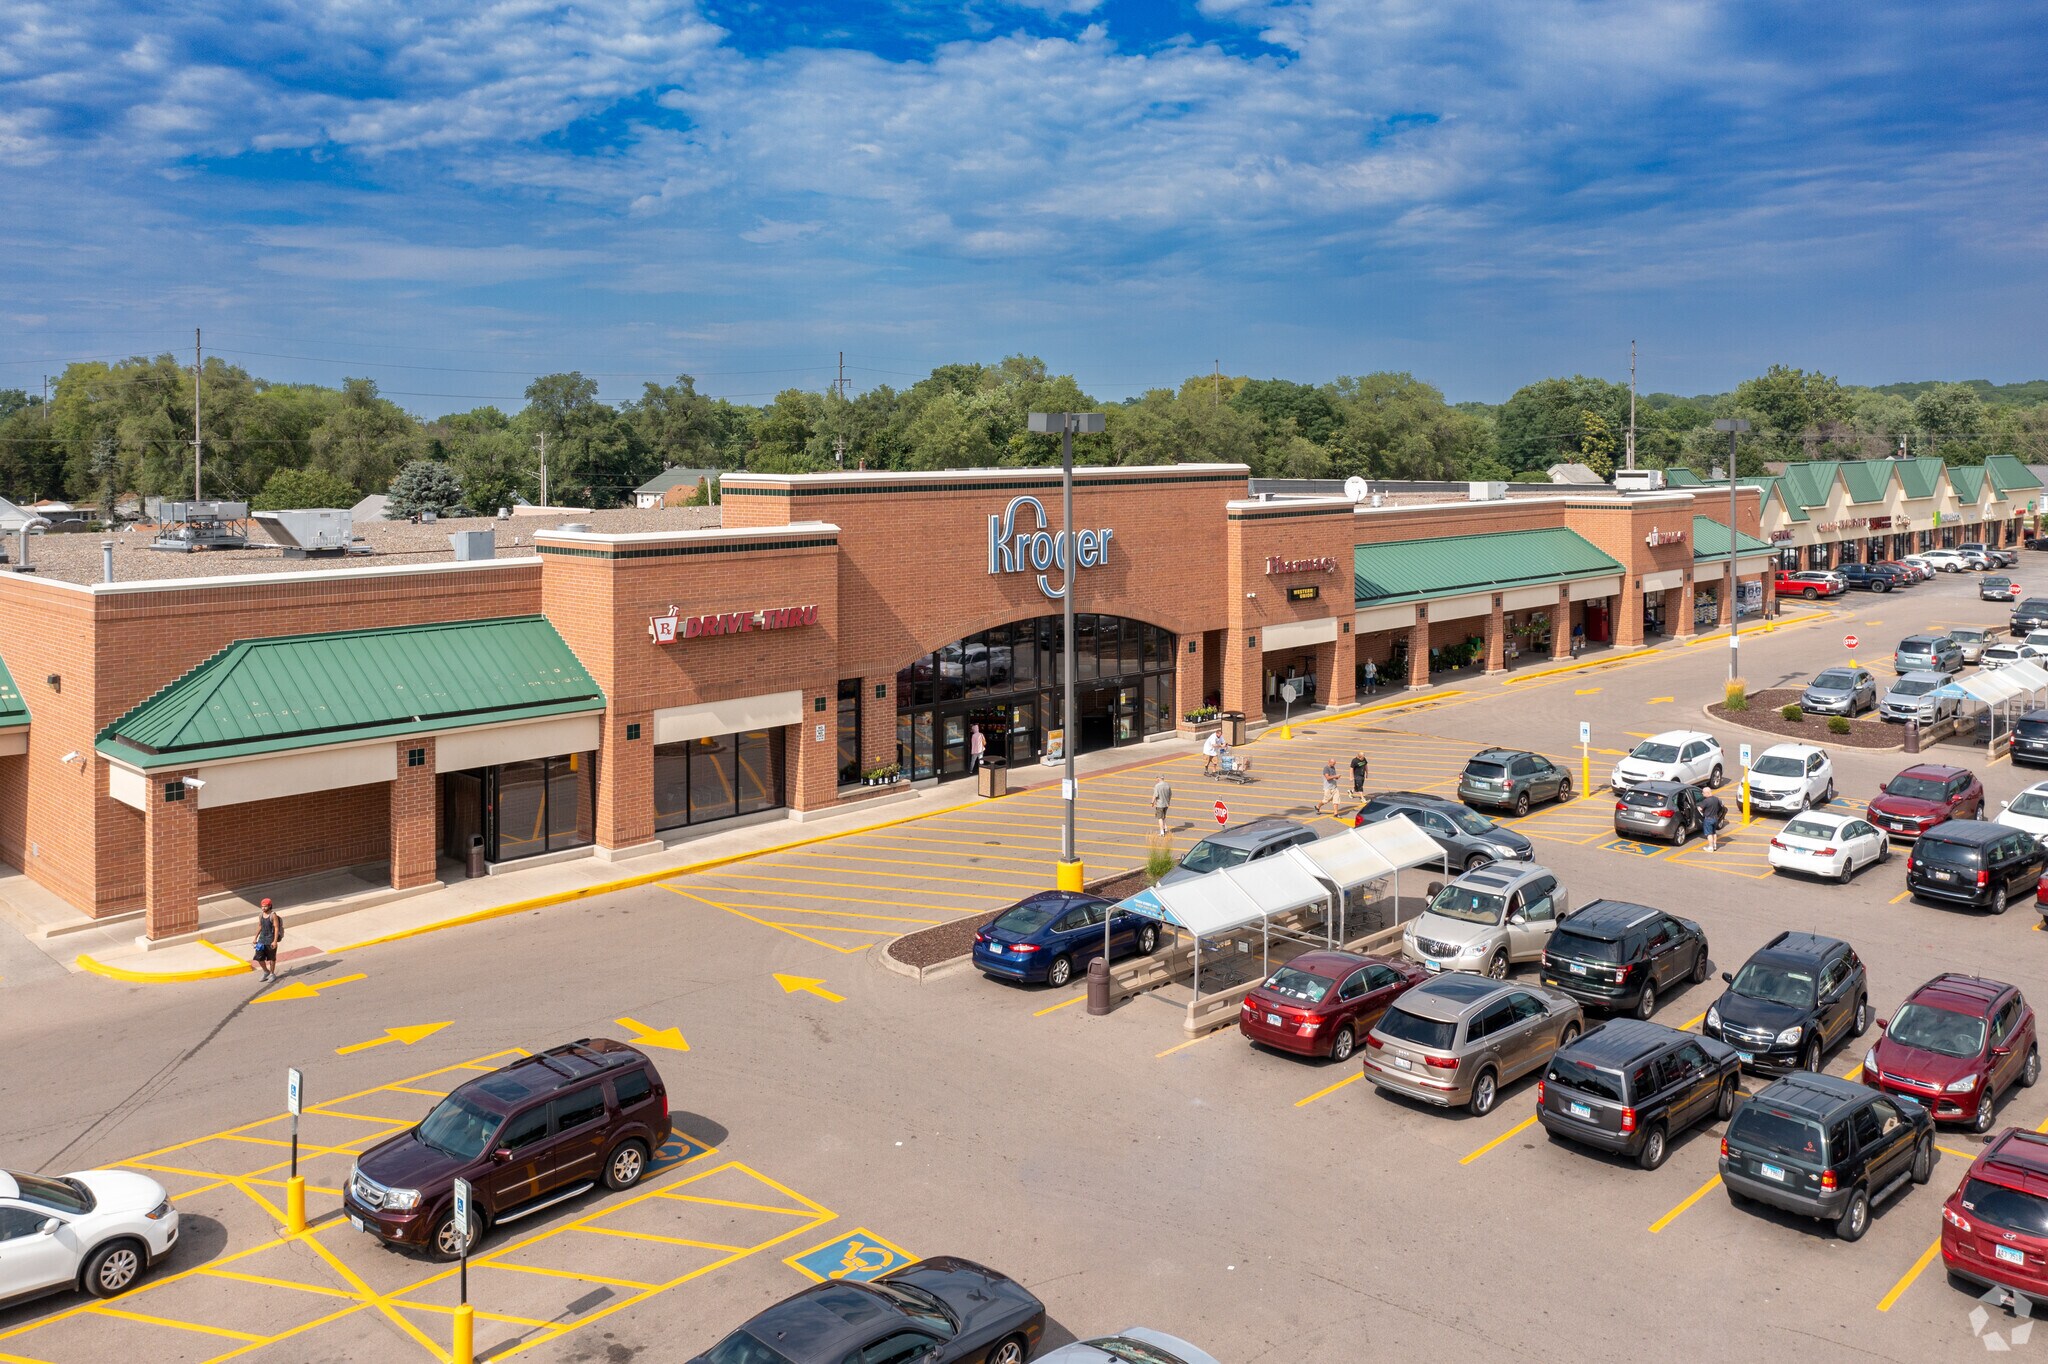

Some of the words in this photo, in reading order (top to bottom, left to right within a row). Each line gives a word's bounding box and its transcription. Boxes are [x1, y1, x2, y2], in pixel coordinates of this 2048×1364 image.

[1771, 529, 1795, 541] GNC
[987, 495, 1113, 598] Kroger
[1265, 556, 1337, 574] Pharmacy
[684, 605, 819, 639] DRIVE-THRU
[1215, 807, 1227, 817] STOP
